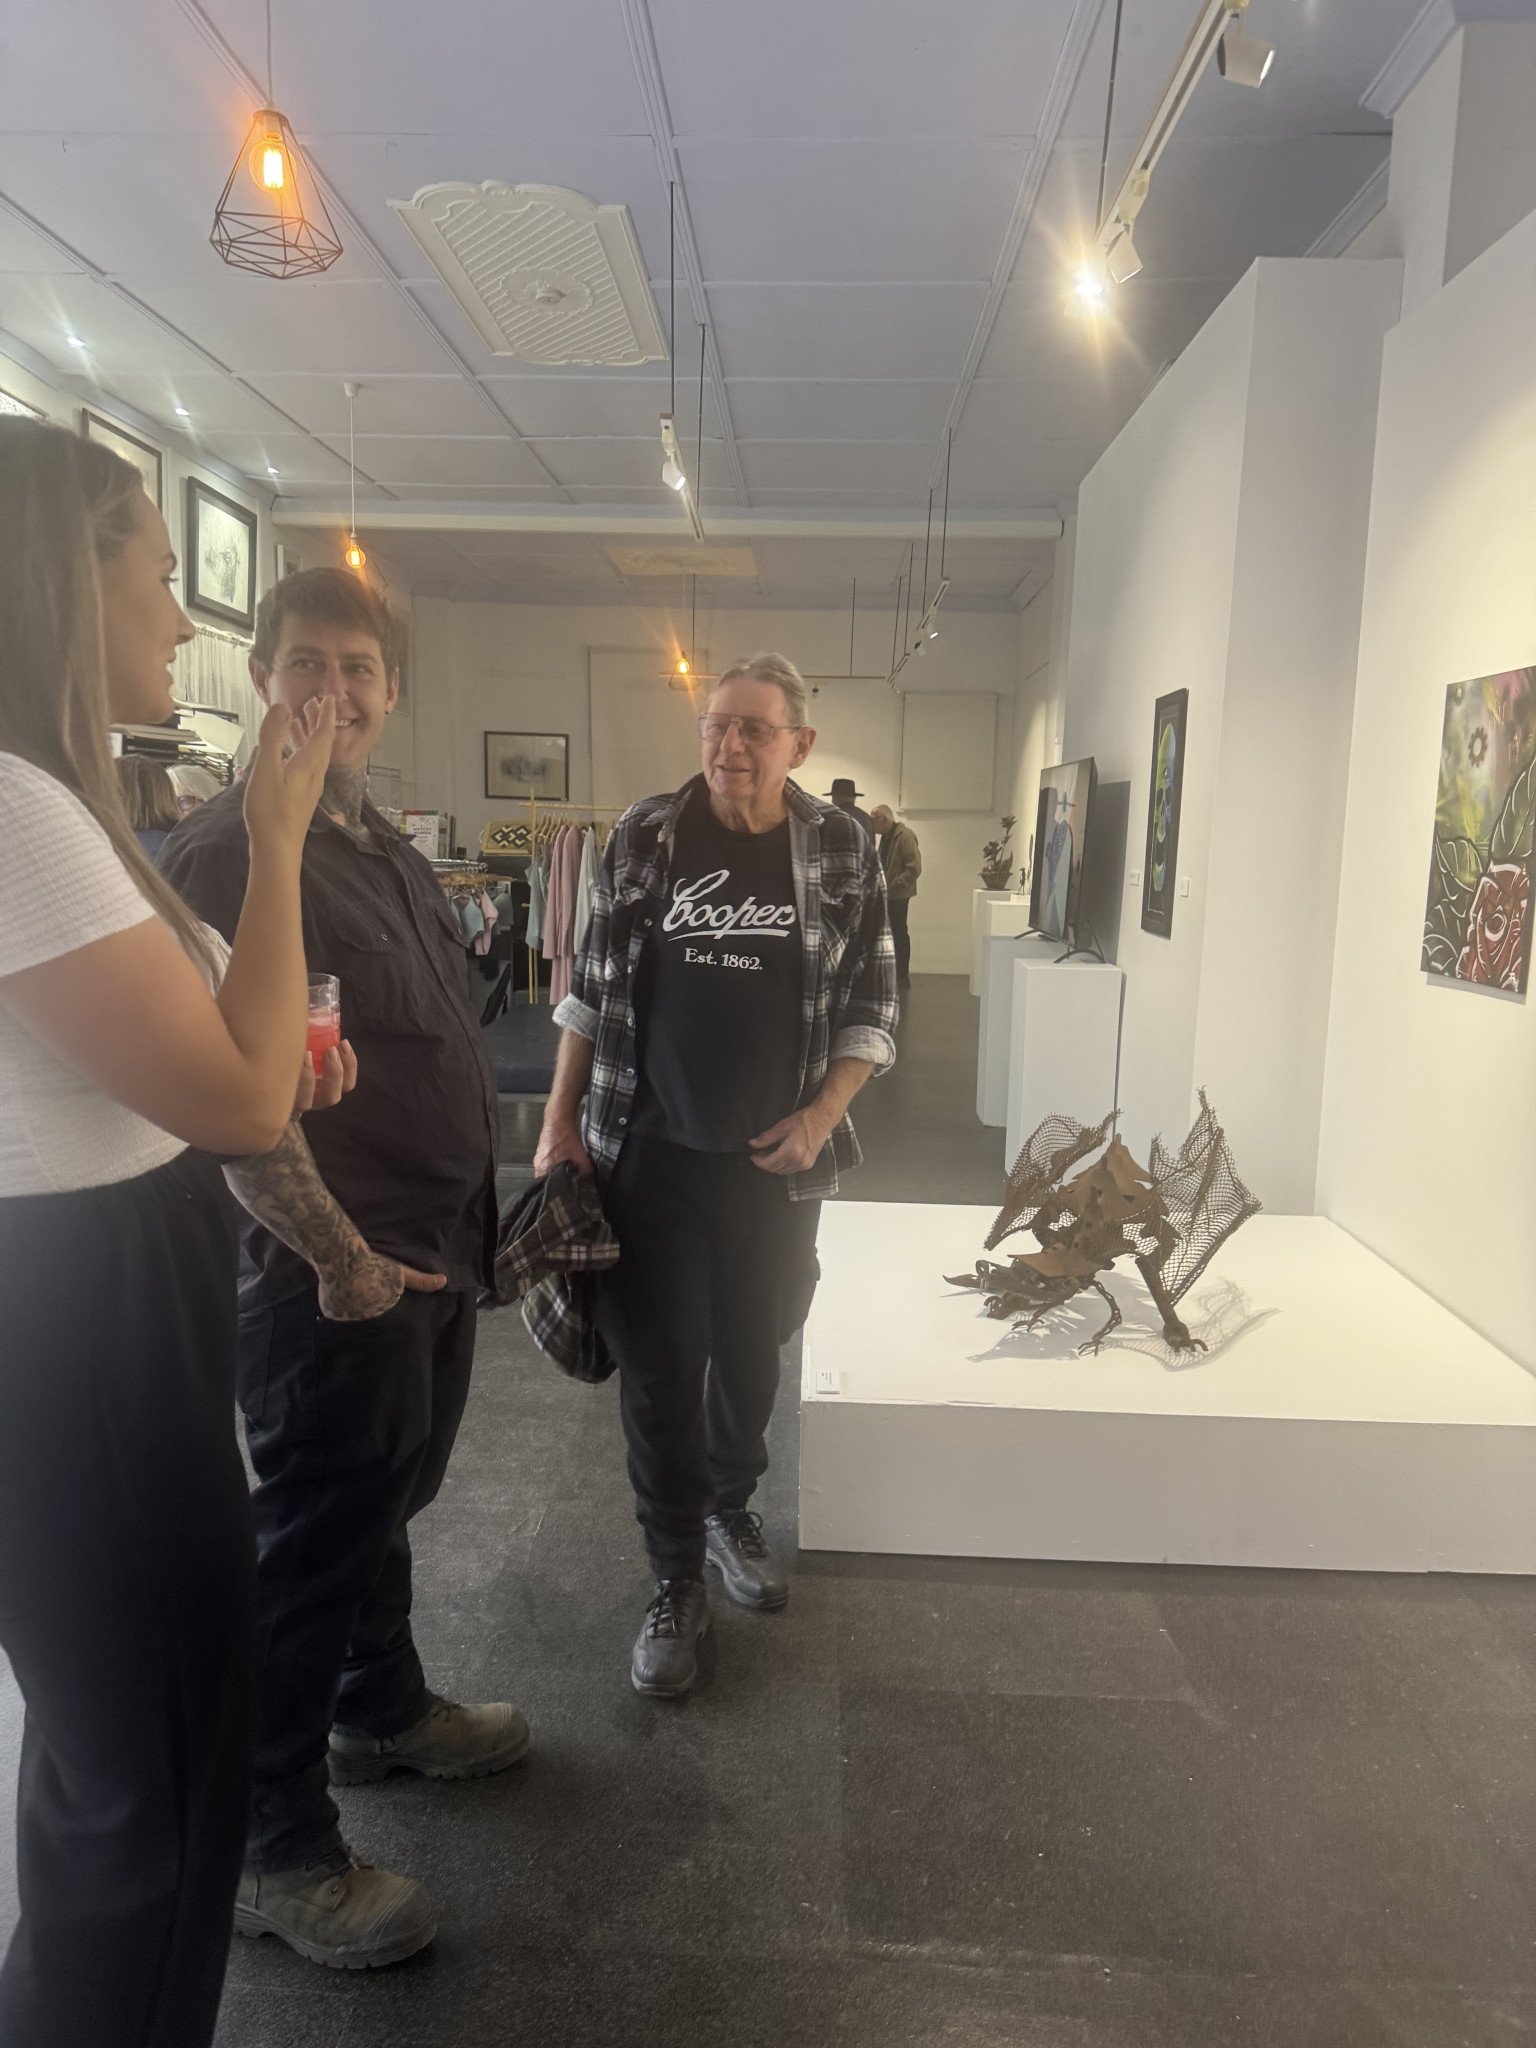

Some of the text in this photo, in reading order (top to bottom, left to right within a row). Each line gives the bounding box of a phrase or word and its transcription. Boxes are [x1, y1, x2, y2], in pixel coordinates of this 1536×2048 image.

[663, 869, 797, 940] Coopers
[684, 947, 763, 970] Est. 1862.
